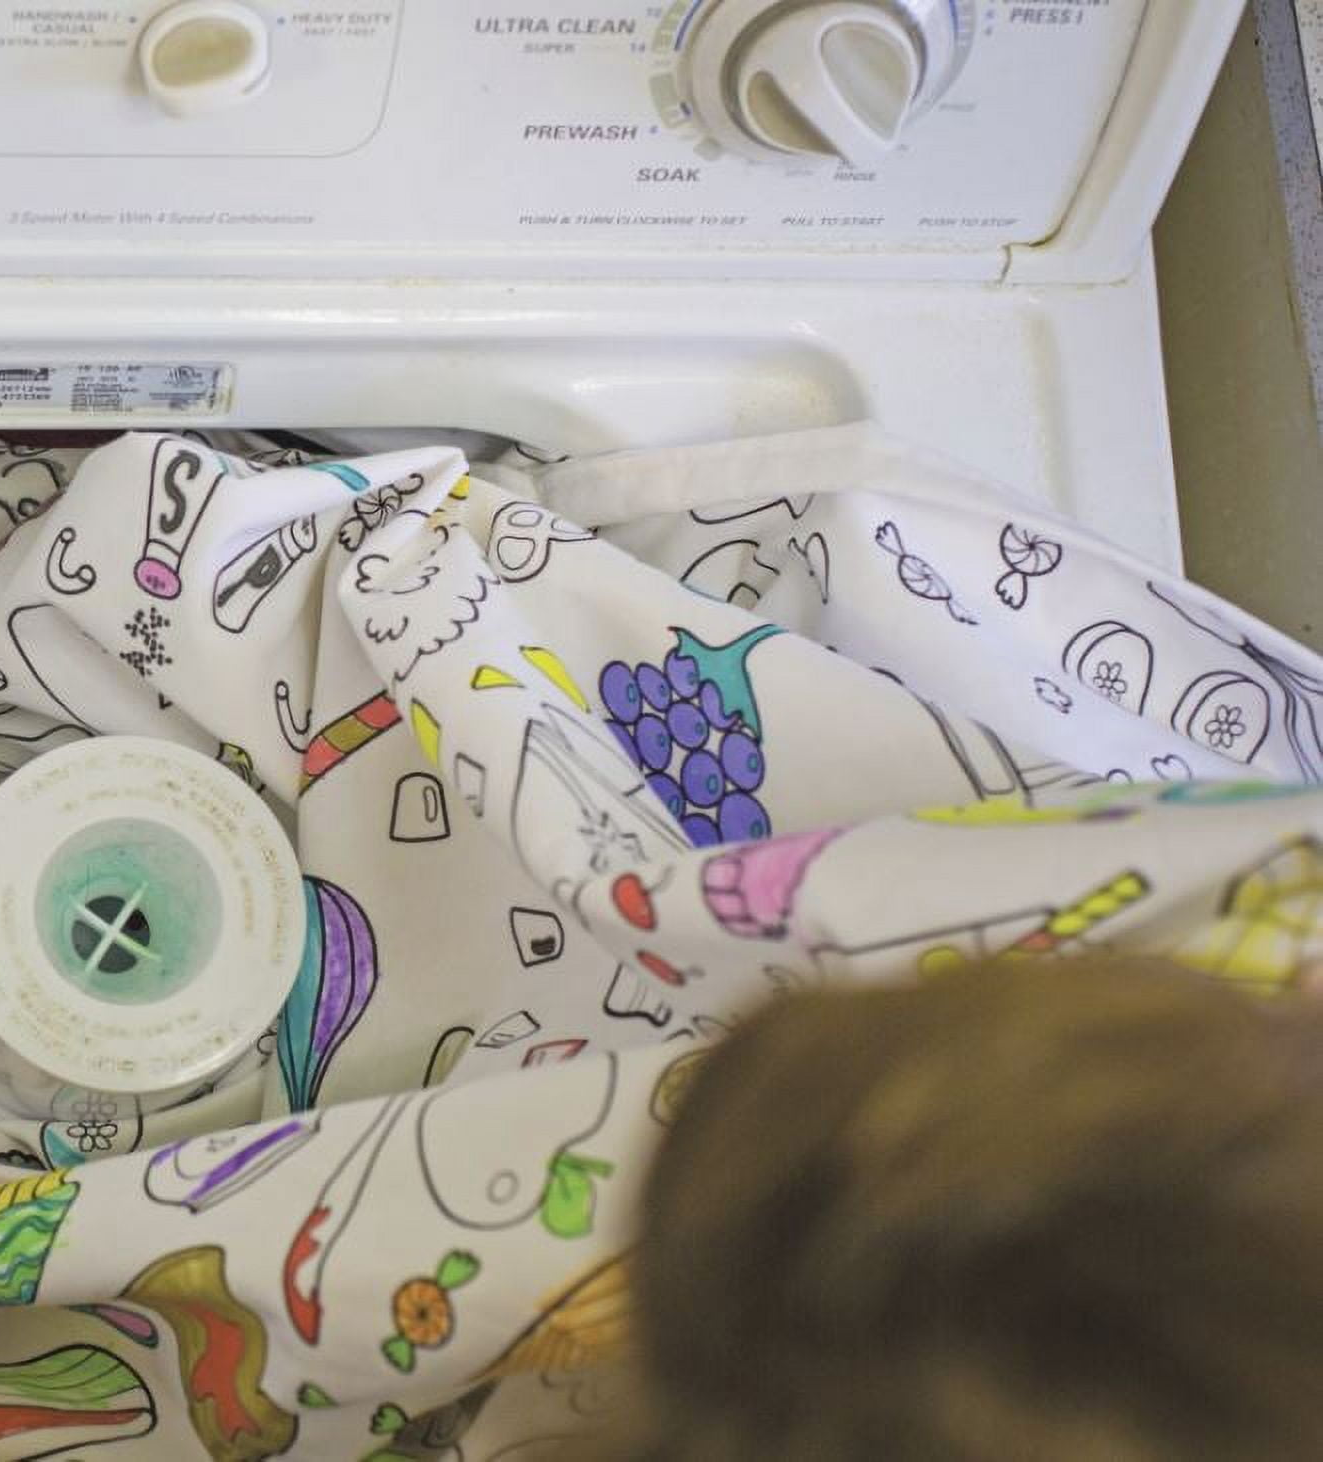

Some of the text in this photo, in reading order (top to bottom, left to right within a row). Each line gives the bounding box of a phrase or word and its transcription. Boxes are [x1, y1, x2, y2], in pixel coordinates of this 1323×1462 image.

[291, 12, 391, 24] HEAVY DUTY
[1010, 8, 1073, 24] PRESS
[31, 23, 95, 34] CASUAL
[475, 18, 637, 34] ULTRA CLEAN
[524, 42, 576, 53] SUPER
[523, 125, 638, 141] PREWASH
[636, 167, 701, 183] SOAK
[118, 210, 153, 224] With
[840, 216, 885, 226] START
[159, 449, 202, 535] S
